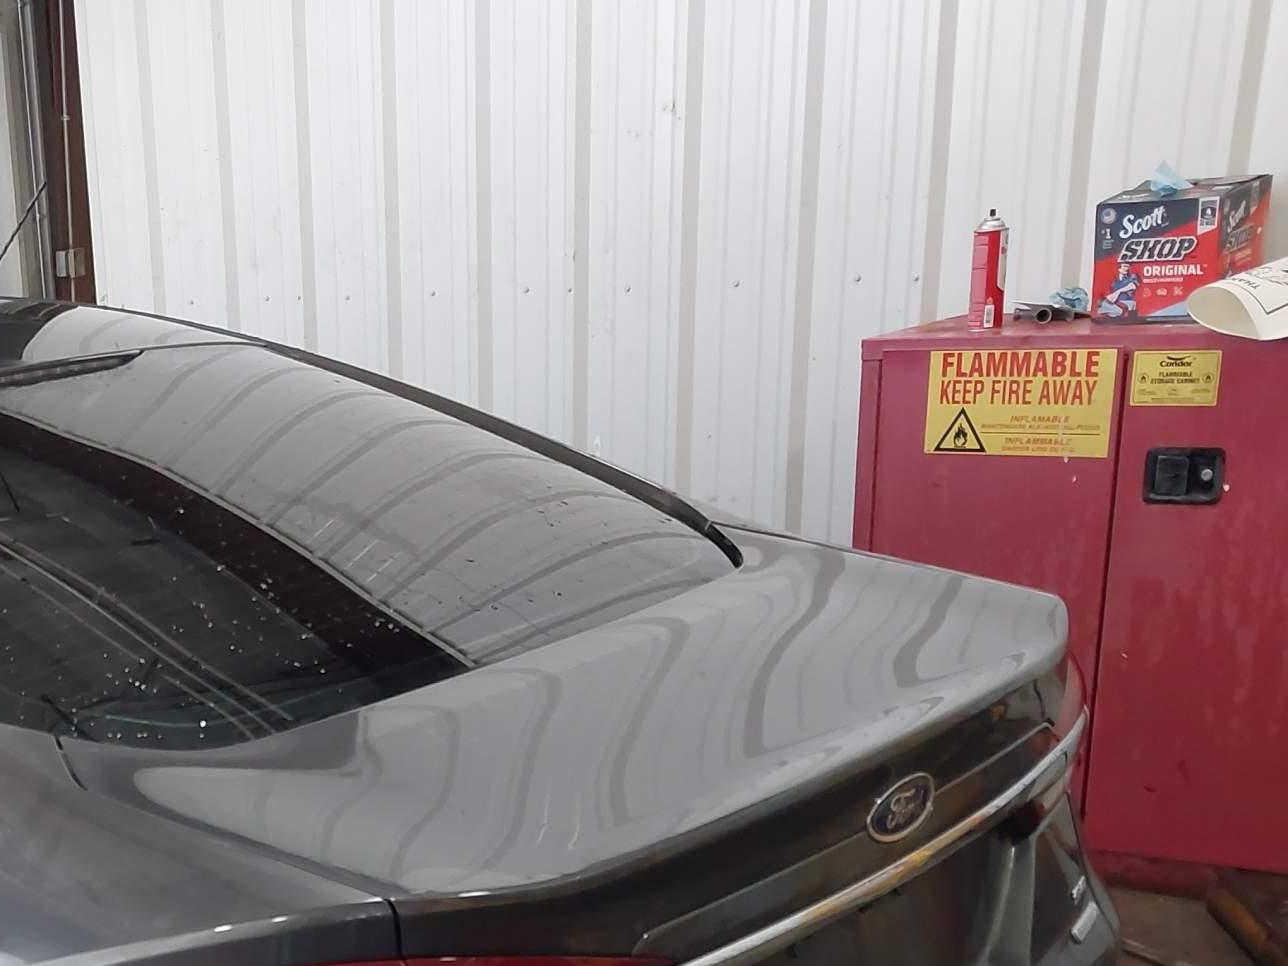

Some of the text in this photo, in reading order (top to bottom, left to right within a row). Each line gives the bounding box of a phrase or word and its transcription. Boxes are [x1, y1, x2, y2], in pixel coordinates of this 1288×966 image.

[1119, 205, 1166, 238] Scott
[1118, 236, 1197, 262] SHOP
[1143, 264, 1203, 276] ORIGINAL
[941, 350, 1101, 378] FLAMMABLE
[939, 379, 1098, 406] KEEP FIRE AWAY
[1010, 415, 1070, 423] INFLAMABLE
